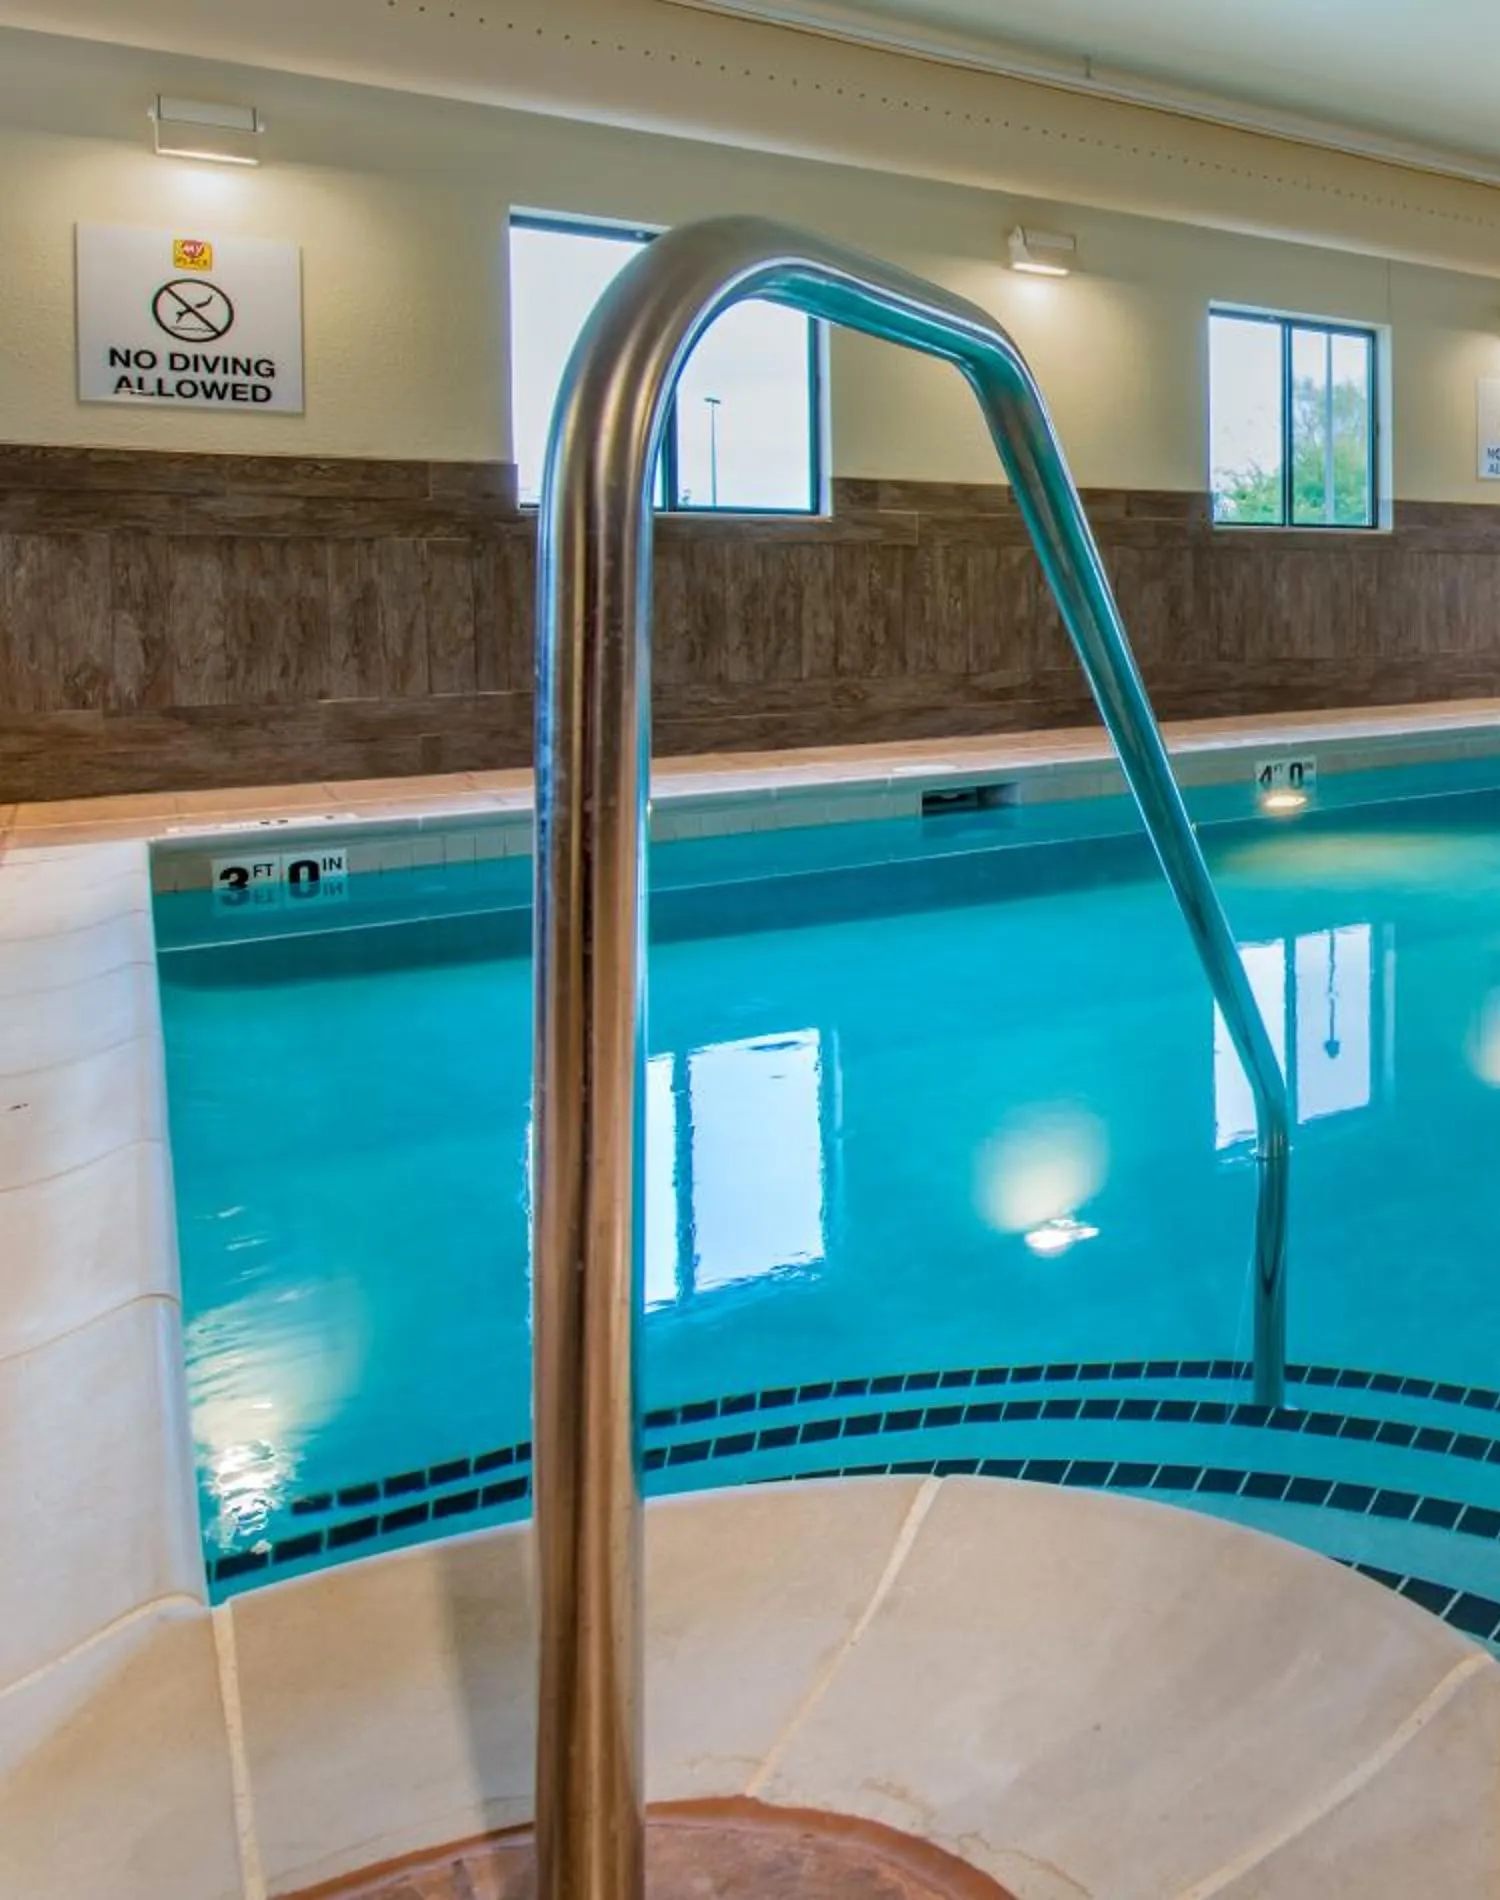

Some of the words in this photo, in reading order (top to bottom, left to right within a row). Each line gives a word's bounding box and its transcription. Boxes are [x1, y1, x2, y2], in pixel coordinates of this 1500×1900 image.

[109, 348, 157, 369] NO
[168, 352, 276, 378] DIVING
[113, 375, 272, 403] ALLOWED
[1259, 765, 1272, 784] 4
[219, 866, 249, 891] 3
[253, 863, 274, 878] FT
[288, 859, 321, 889] 0
[323, 857, 343, 872] IN
